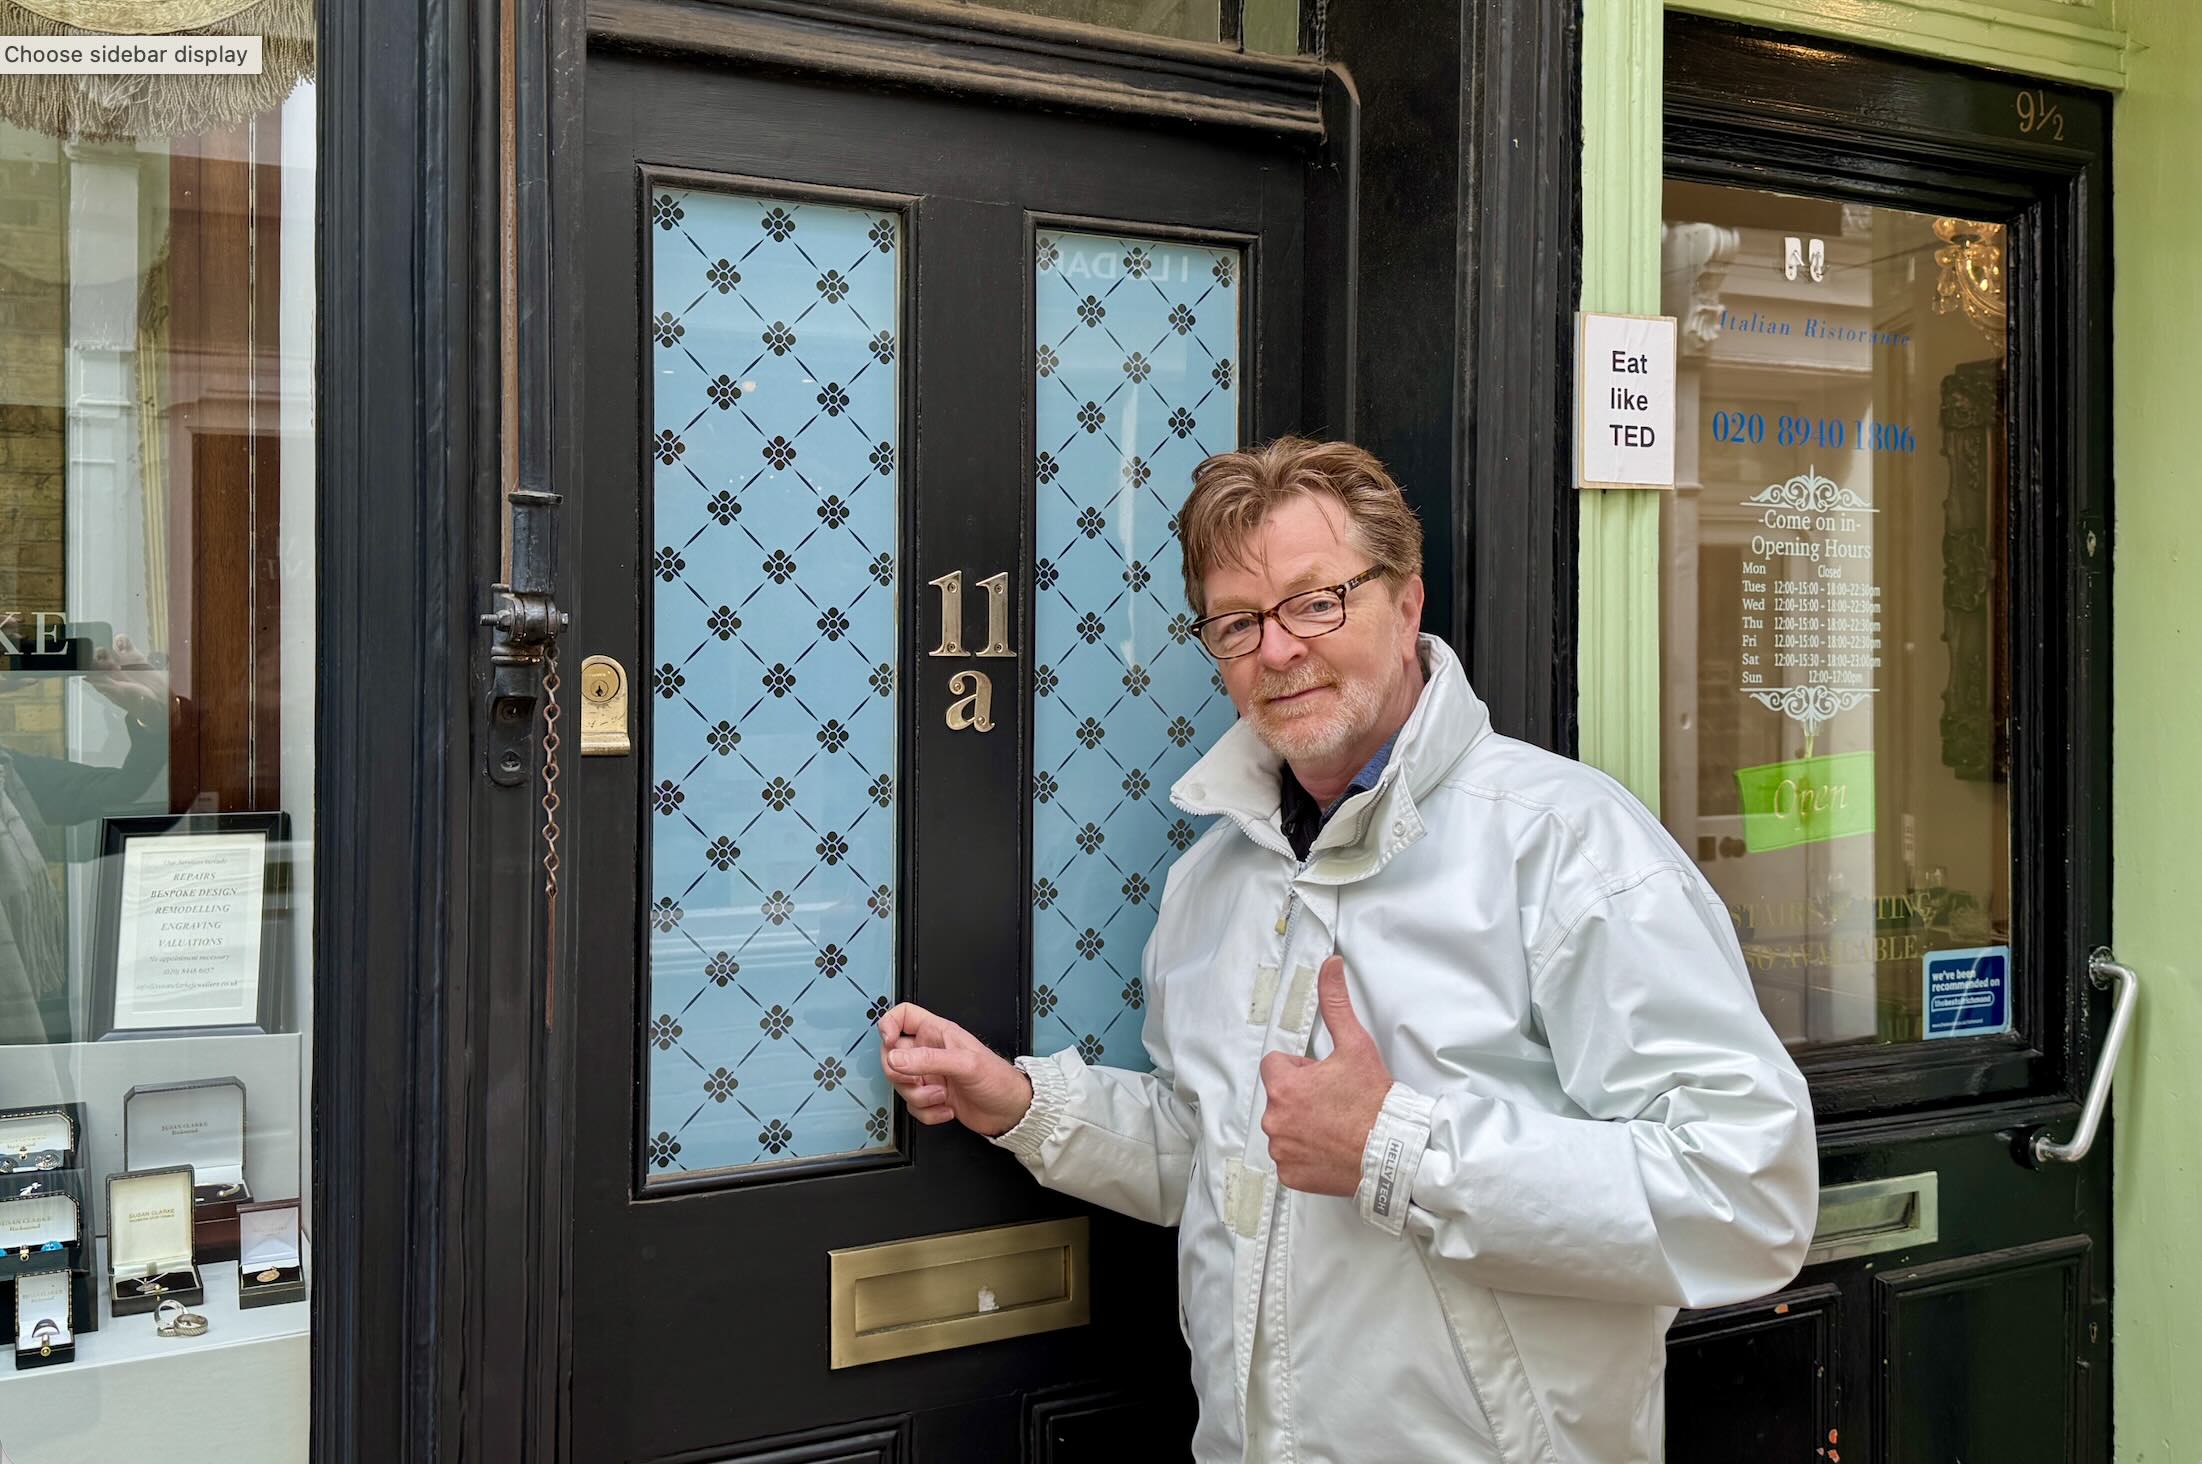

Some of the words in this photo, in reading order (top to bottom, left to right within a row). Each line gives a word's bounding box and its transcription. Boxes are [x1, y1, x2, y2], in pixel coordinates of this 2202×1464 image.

[1719, 310, 1792, 336] Italian
[1804, 318, 1911, 346] Ristorante
[1612, 350, 1648, 374] Eat
[1611, 387, 1648, 411] like
[1609, 424, 1655, 448] TED
[1713, 410, 1765, 445] 020
[1778, 415, 1845, 448] 8940
[1855, 419, 1916, 454] 1806
[1816, 517, 1835, 531] on
[1752, 536, 1820, 562] Opening
[1824, 539, 1872, 559] Hours
[1743, 562, 1766, 574] Mon
[1818, 565, 1841, 578] Closed
[1742, 580, 1766, 592] Tues
[1742, 599, 1765, 610] Wed
[928, 570, 1017, 657] 11
[1742, 616, 1763, 629] Thu
[1742, 635, 1757, 647] Fri
[1742, 653, 1760, 666] Sat
[1742, 671, 1763, 683] Sun
[946, 670, 996, 733] a
[1774, 779, 1847, 819] Open
[173, 872, 216, 881] REPAIRS
[150, 889, 196, 898] BESPOKE
[198, 888, 239, 896] DESIGN
[155, 904, 231, 915] REMODELLING
[160, 921, 223, 931] ENGRAVING
[158, 938, 224, 948] VALUATIONS
[1931, 970, 1955, 981] we've
[1956, 968, 1976, 979] been
[1931, 978, 1989, 992] recommended
[1990, 978, 2001, 987] on
[1384, 1142, 1400, 1180] HELLY
[1377, 1182, 1391, 1211] TECH
